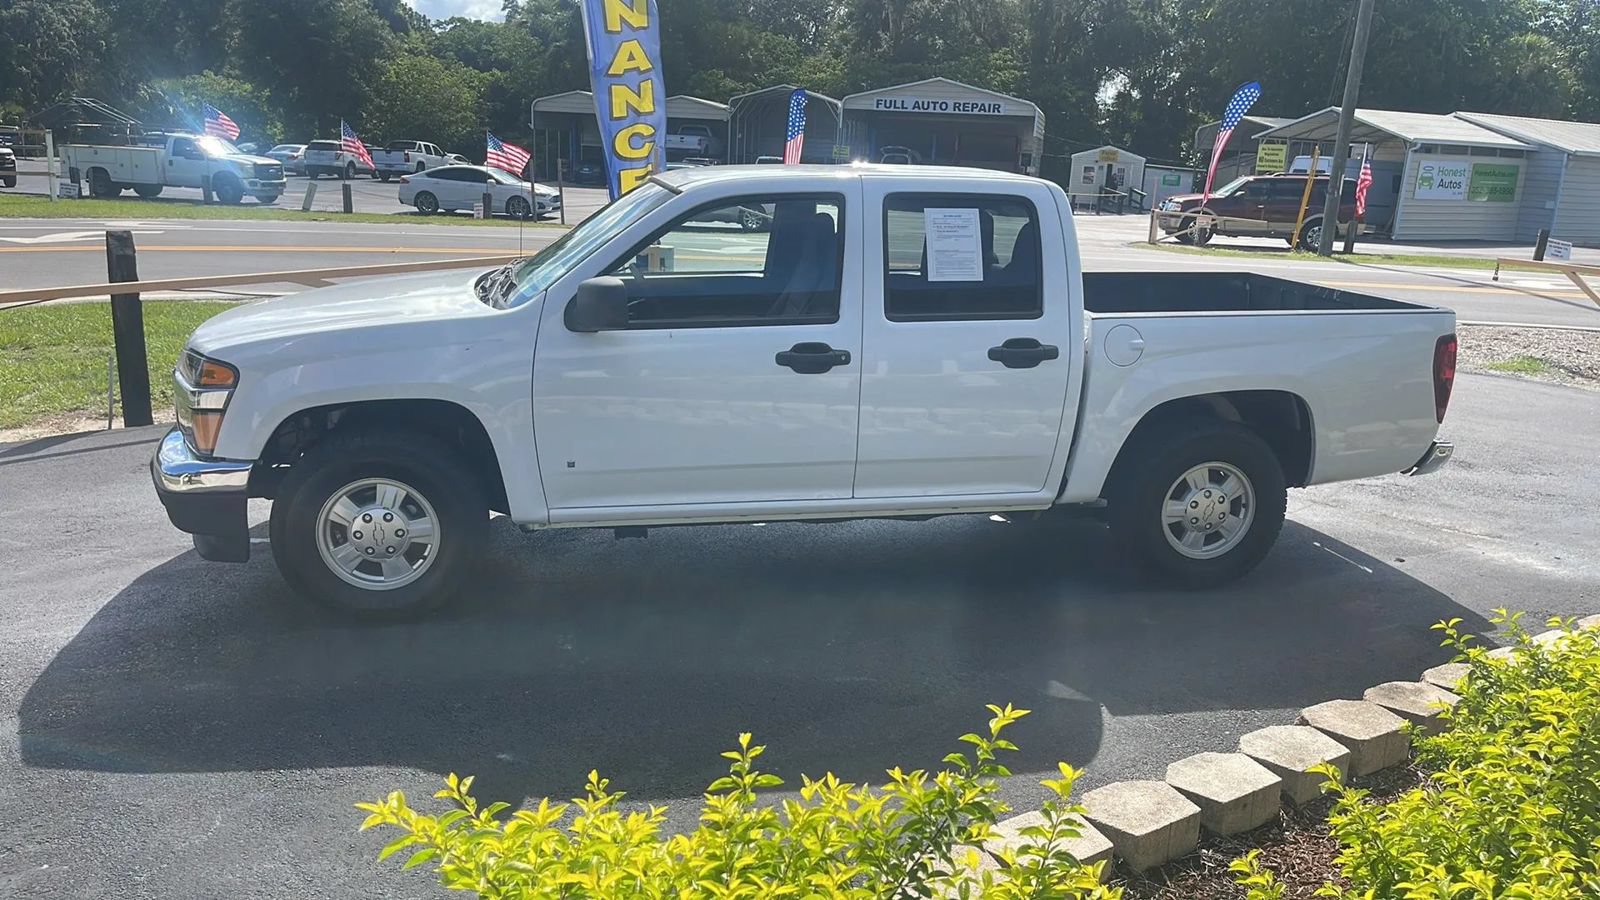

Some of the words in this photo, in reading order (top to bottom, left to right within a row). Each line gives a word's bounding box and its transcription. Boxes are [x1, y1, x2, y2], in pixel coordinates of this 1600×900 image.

[875, 99, 909, 110] FULL
[911, 100, 949, 112] AUTO
[952, 101, 1002, 113] REPAIR
[1436, 166, 1467, 177] Honest
[1436, 178, 1462, 190] Autos
